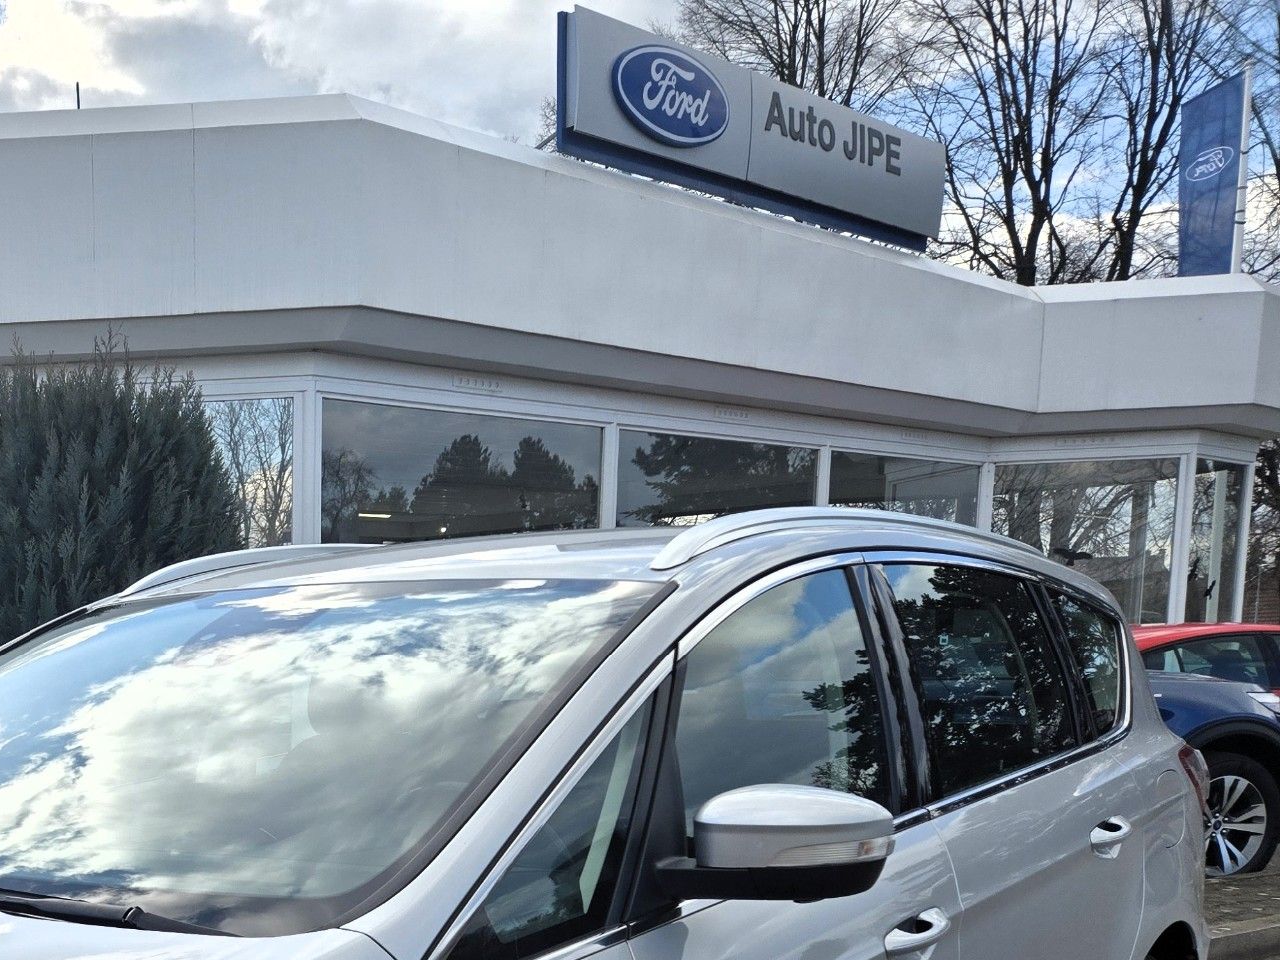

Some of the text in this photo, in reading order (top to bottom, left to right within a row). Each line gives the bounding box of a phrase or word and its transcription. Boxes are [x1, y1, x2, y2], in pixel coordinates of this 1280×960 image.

[643, 58, 710, 126] Ford
[765, 91, 902, 176] Auto JIPE
